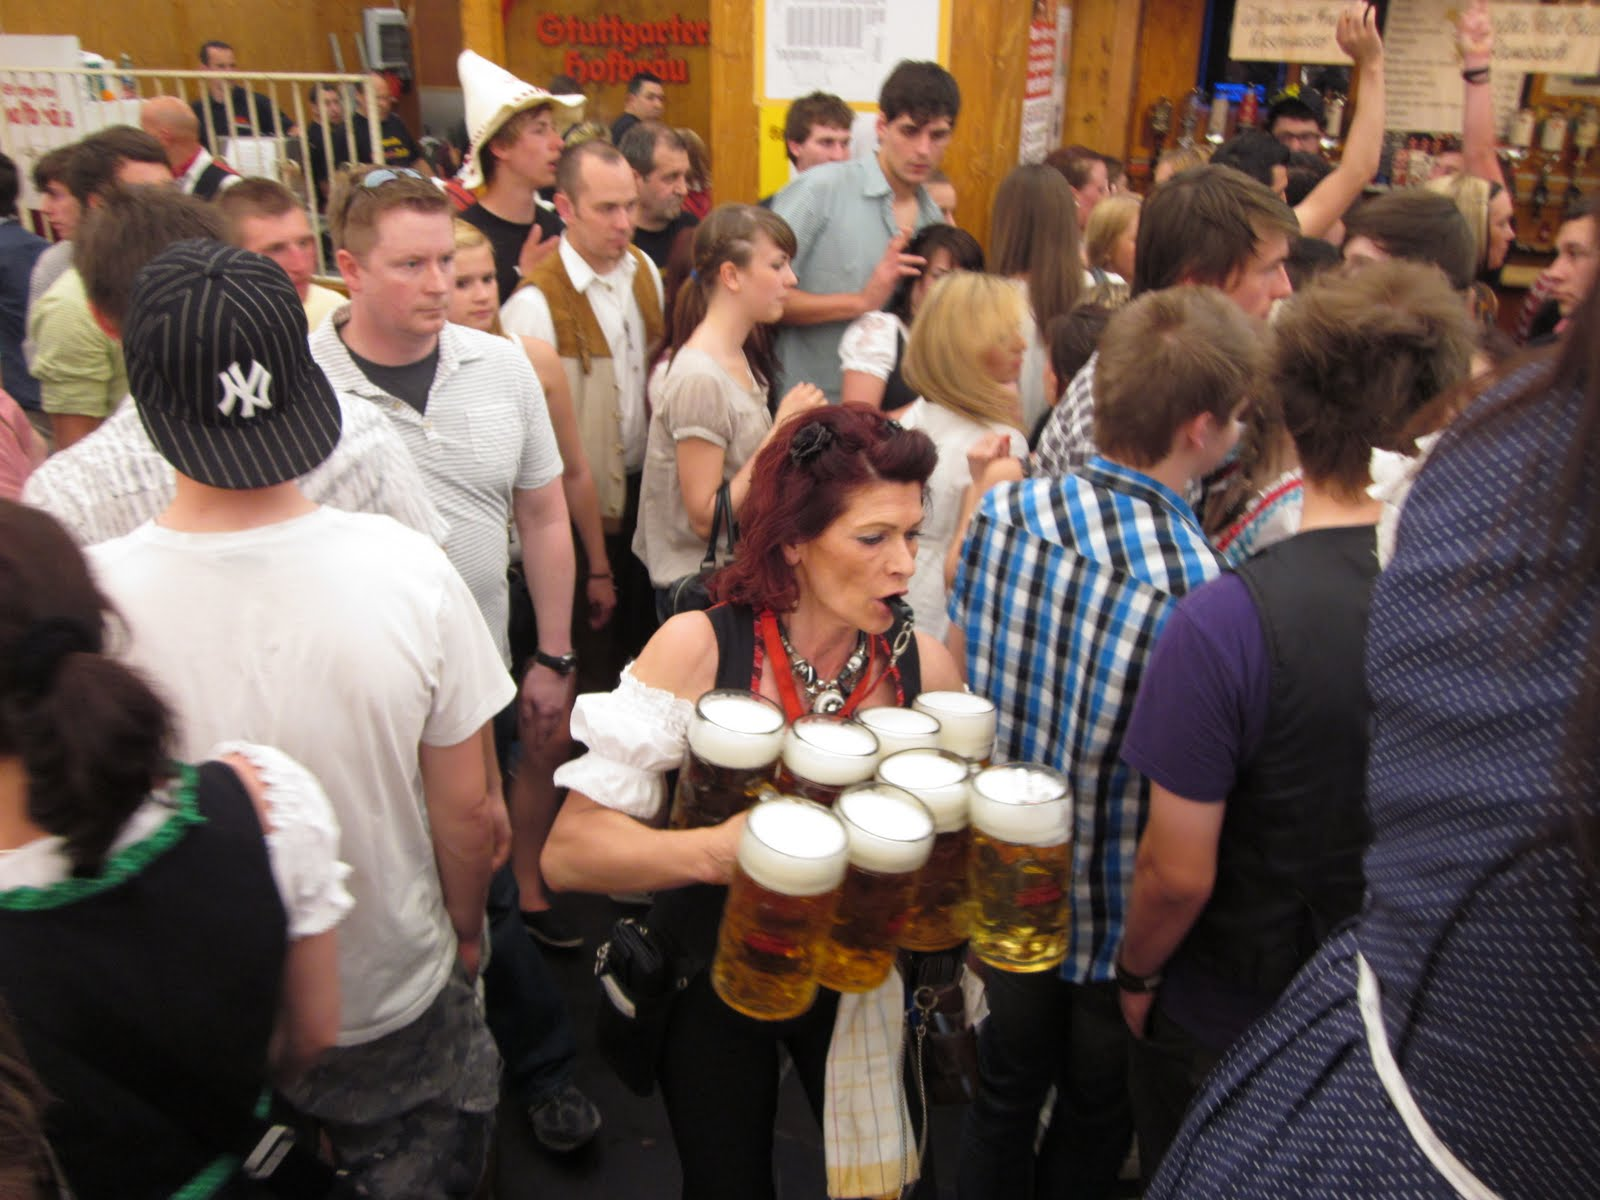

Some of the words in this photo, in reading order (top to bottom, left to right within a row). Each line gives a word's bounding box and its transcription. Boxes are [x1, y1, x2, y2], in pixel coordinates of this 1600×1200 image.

[537, 13, 709, 52] Stuttgarter
[564, 49, 687, 84] Hofbräu
[217, 359, 272, 419] NY
